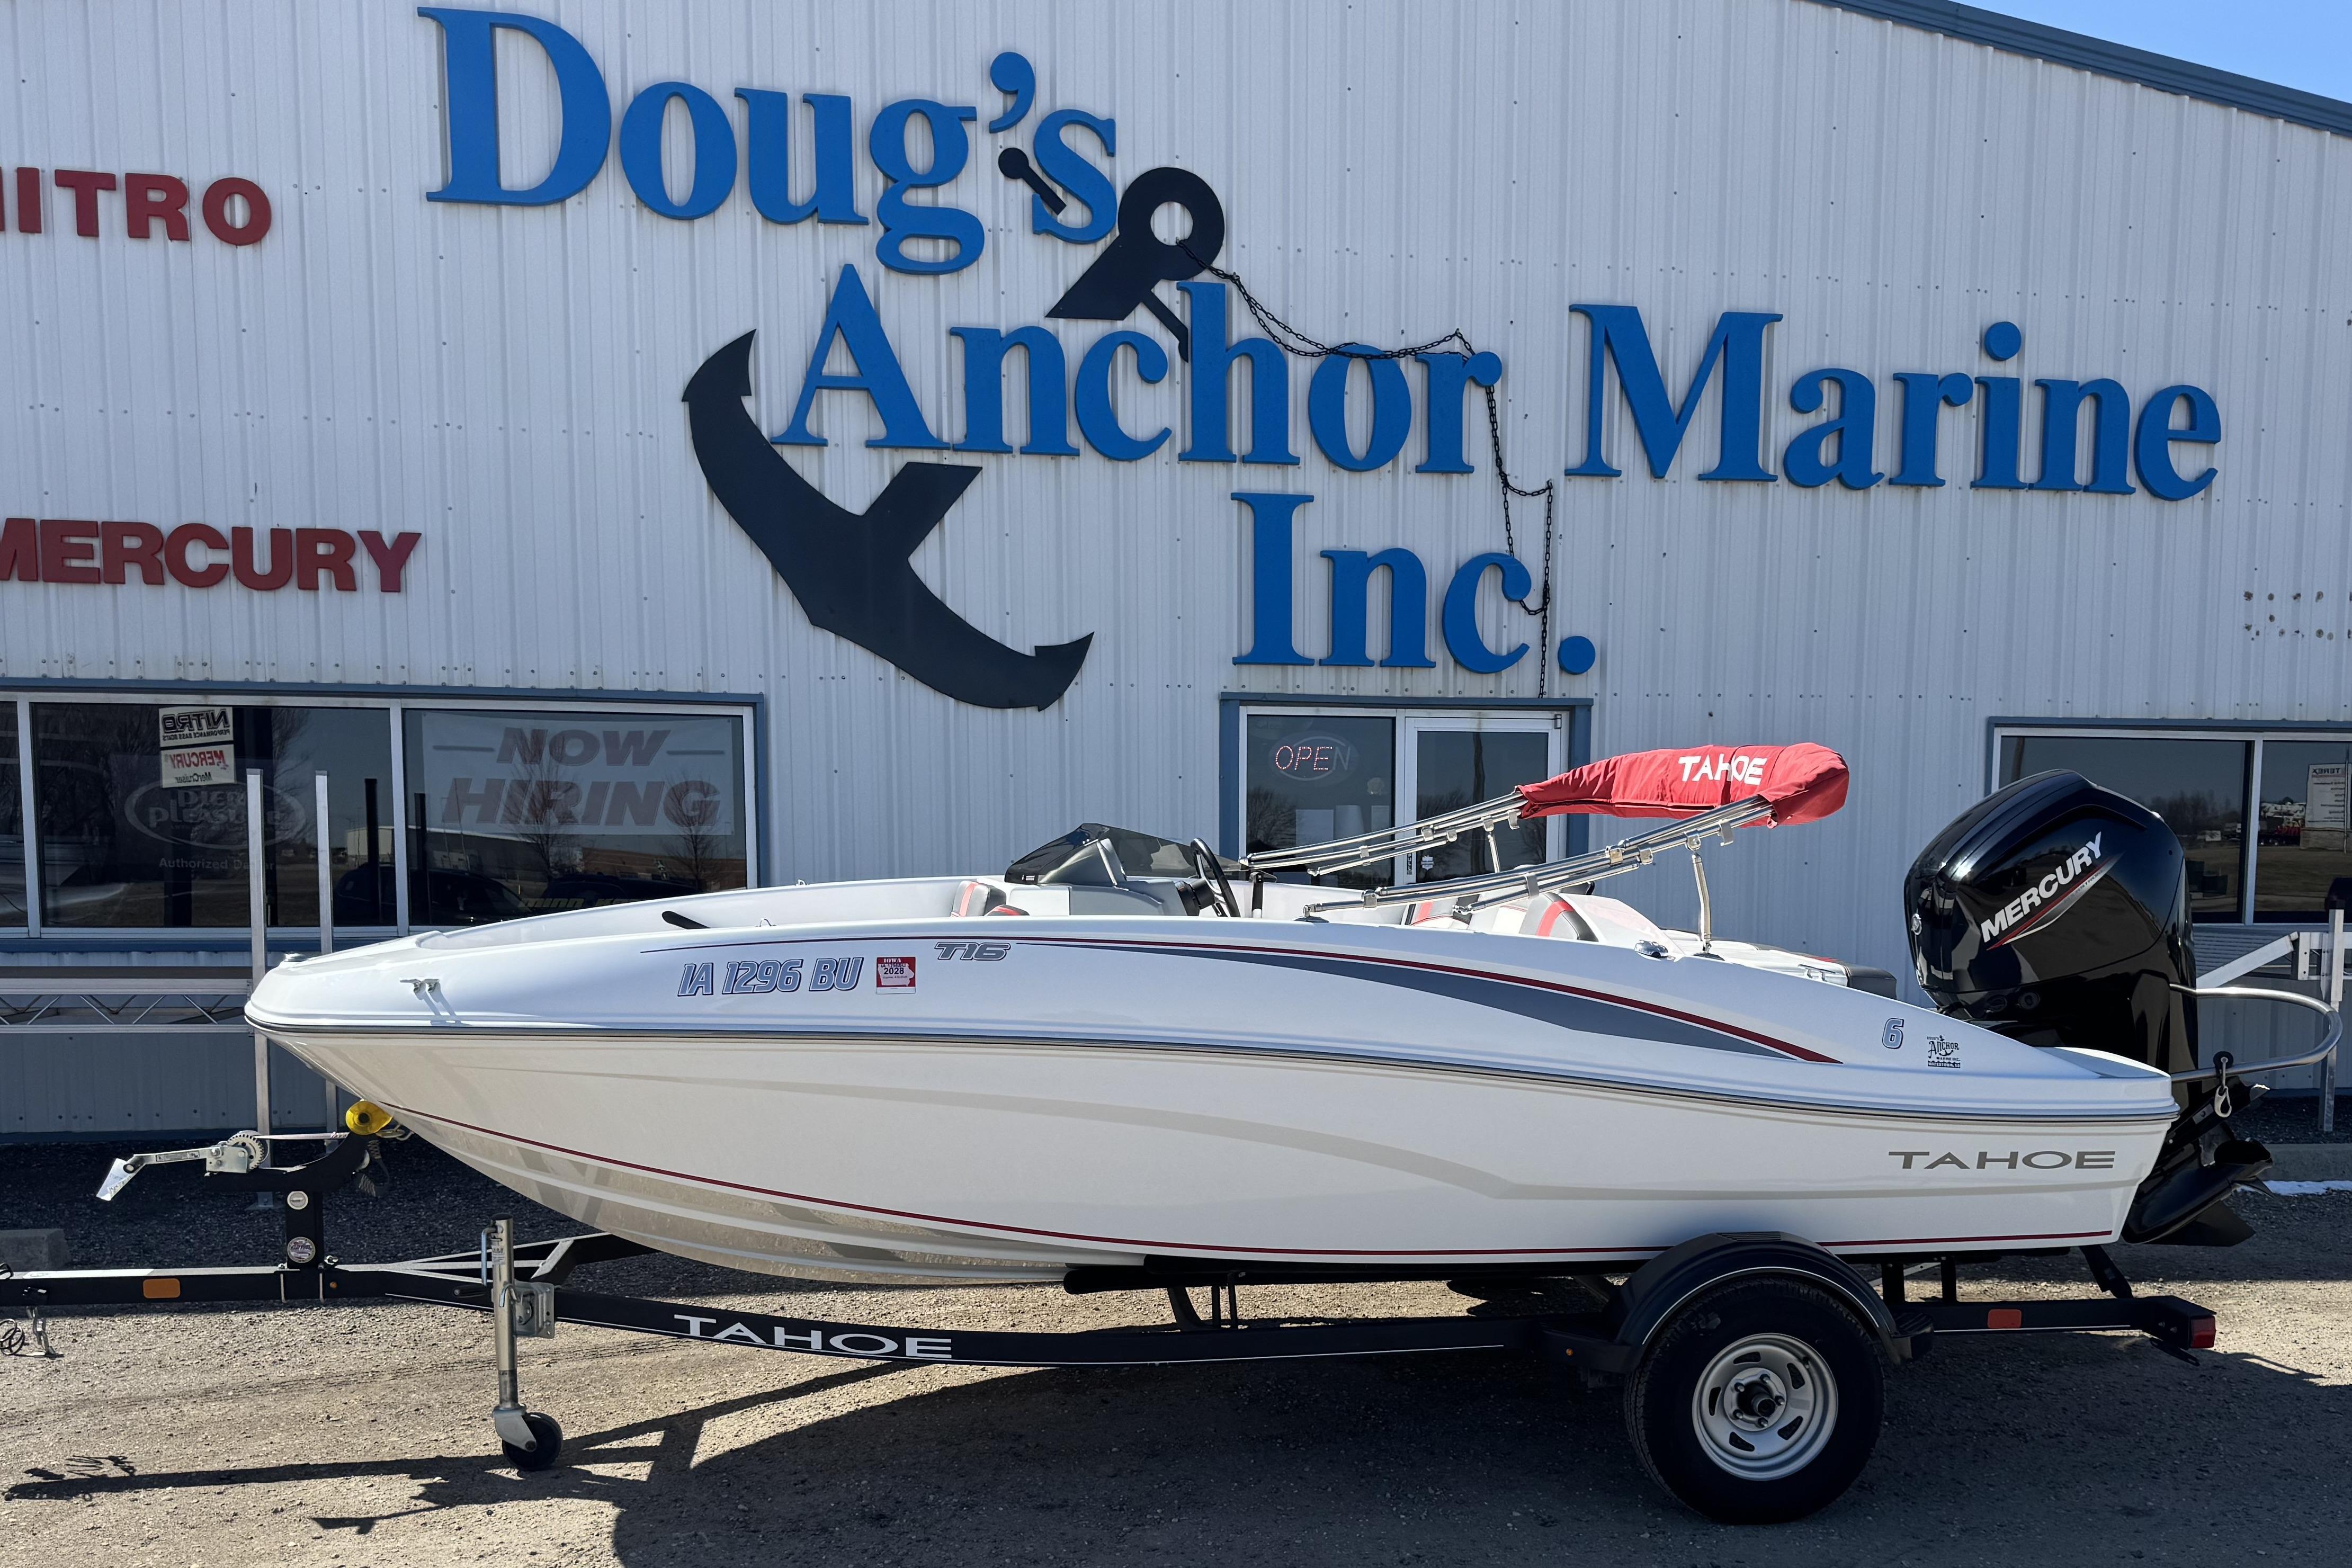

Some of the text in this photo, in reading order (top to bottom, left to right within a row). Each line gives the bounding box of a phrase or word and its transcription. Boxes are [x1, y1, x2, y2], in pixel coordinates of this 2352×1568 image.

[417, 7, 1118, 275] Doug's
[0, 166, 272, 246] ITRO
[771, 264, 2221, 502] Anchor Marine
[1231, 492, 1596, 675] Inc.
[496, 727, 670, 766] NOW
[1275, 746, 1351, 770] OPEN
[1678, 754, 1767, 785] TAHOE
[148, 799, 286, 828] PLEASUE
[441, 778, 721, 827] HIRING
[159, 857, 274, 870] Authorized Deer
[1981, 831, 2101, 943] MERCURY
[934, 942, 1011, 961] T16
[677, 957, 864, 997] IA 1296 BU
[1882, 1018, 1904, 1049] 6
[1889, 1151, 2116, 1170] TAHOE
[674, 1314, 952, 1358] TAHOE
